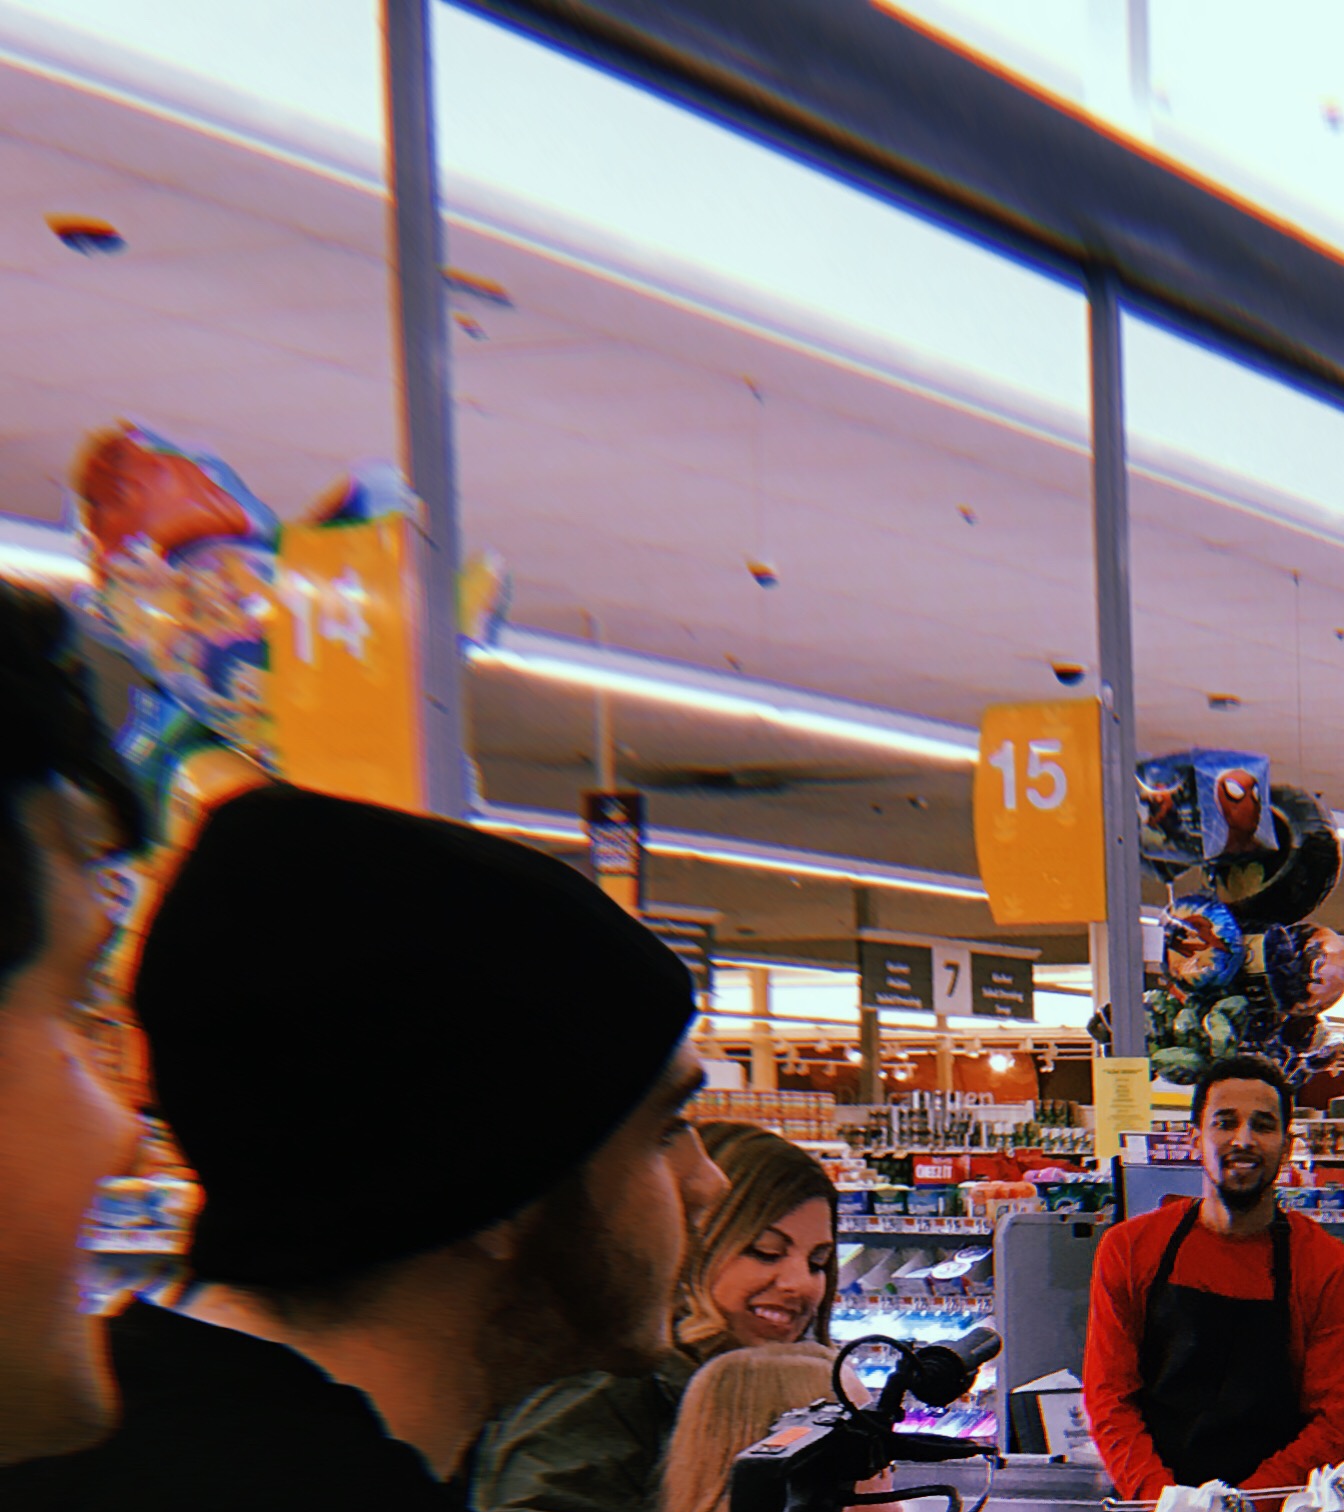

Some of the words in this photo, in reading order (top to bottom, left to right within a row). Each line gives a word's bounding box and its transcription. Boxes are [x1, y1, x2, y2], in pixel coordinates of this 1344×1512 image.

[280, 566, 370, 664] 14
[989, 739, 1068, 811] 15
[944, 961, 960, 998] 7
